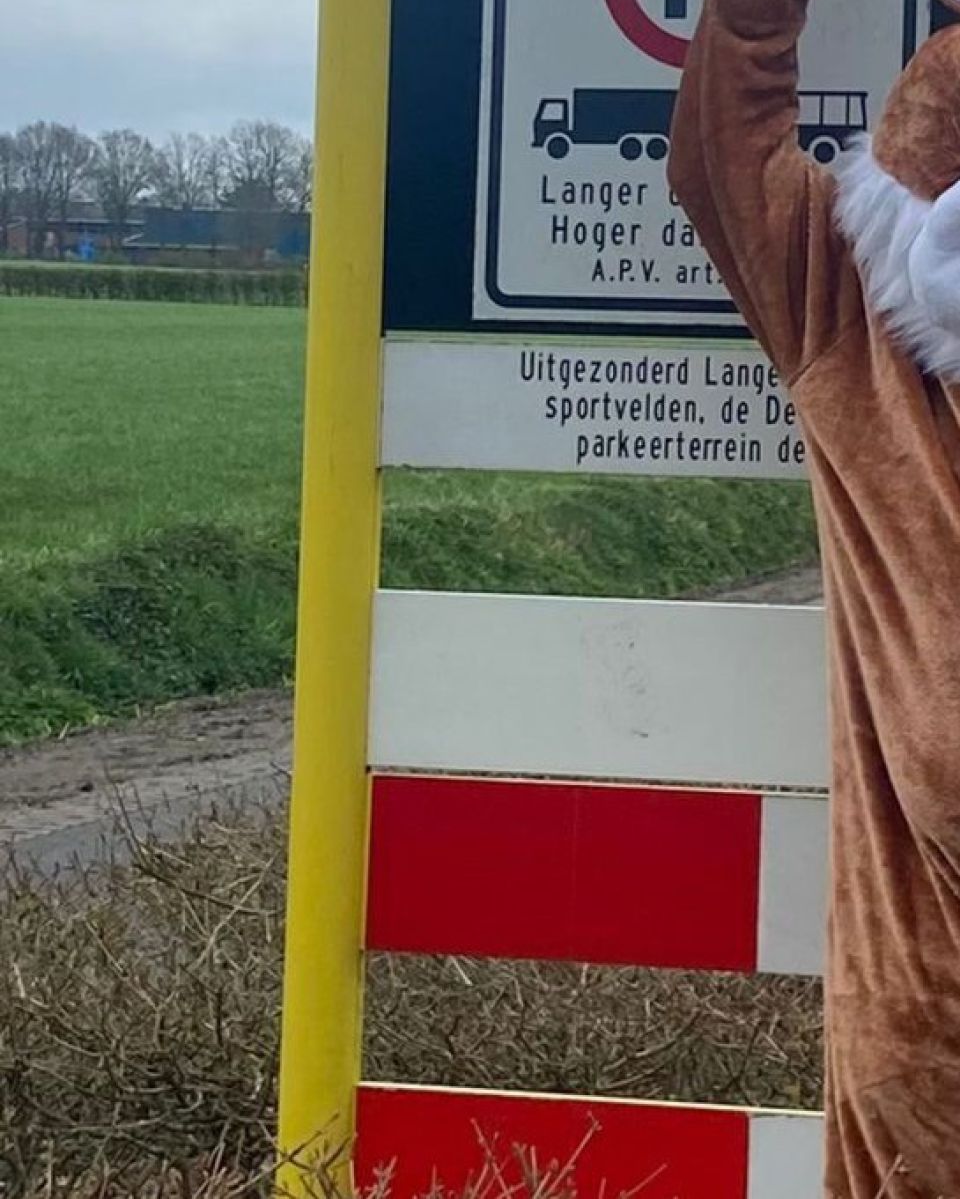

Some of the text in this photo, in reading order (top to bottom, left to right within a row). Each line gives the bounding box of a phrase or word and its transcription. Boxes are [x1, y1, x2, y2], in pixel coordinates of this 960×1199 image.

[541, 175, 648, 211] Langer
[551, 215, 696, 252] Hoger da
[592, 259, 723, 284] A.P.V. art.
[520, 351, 778, 395] Uitgezonderd Lange
[722, 396, 749, 424] de
[766, 395, 796, 425] De
[577, 430, 805, 465] parkeerterrein de
